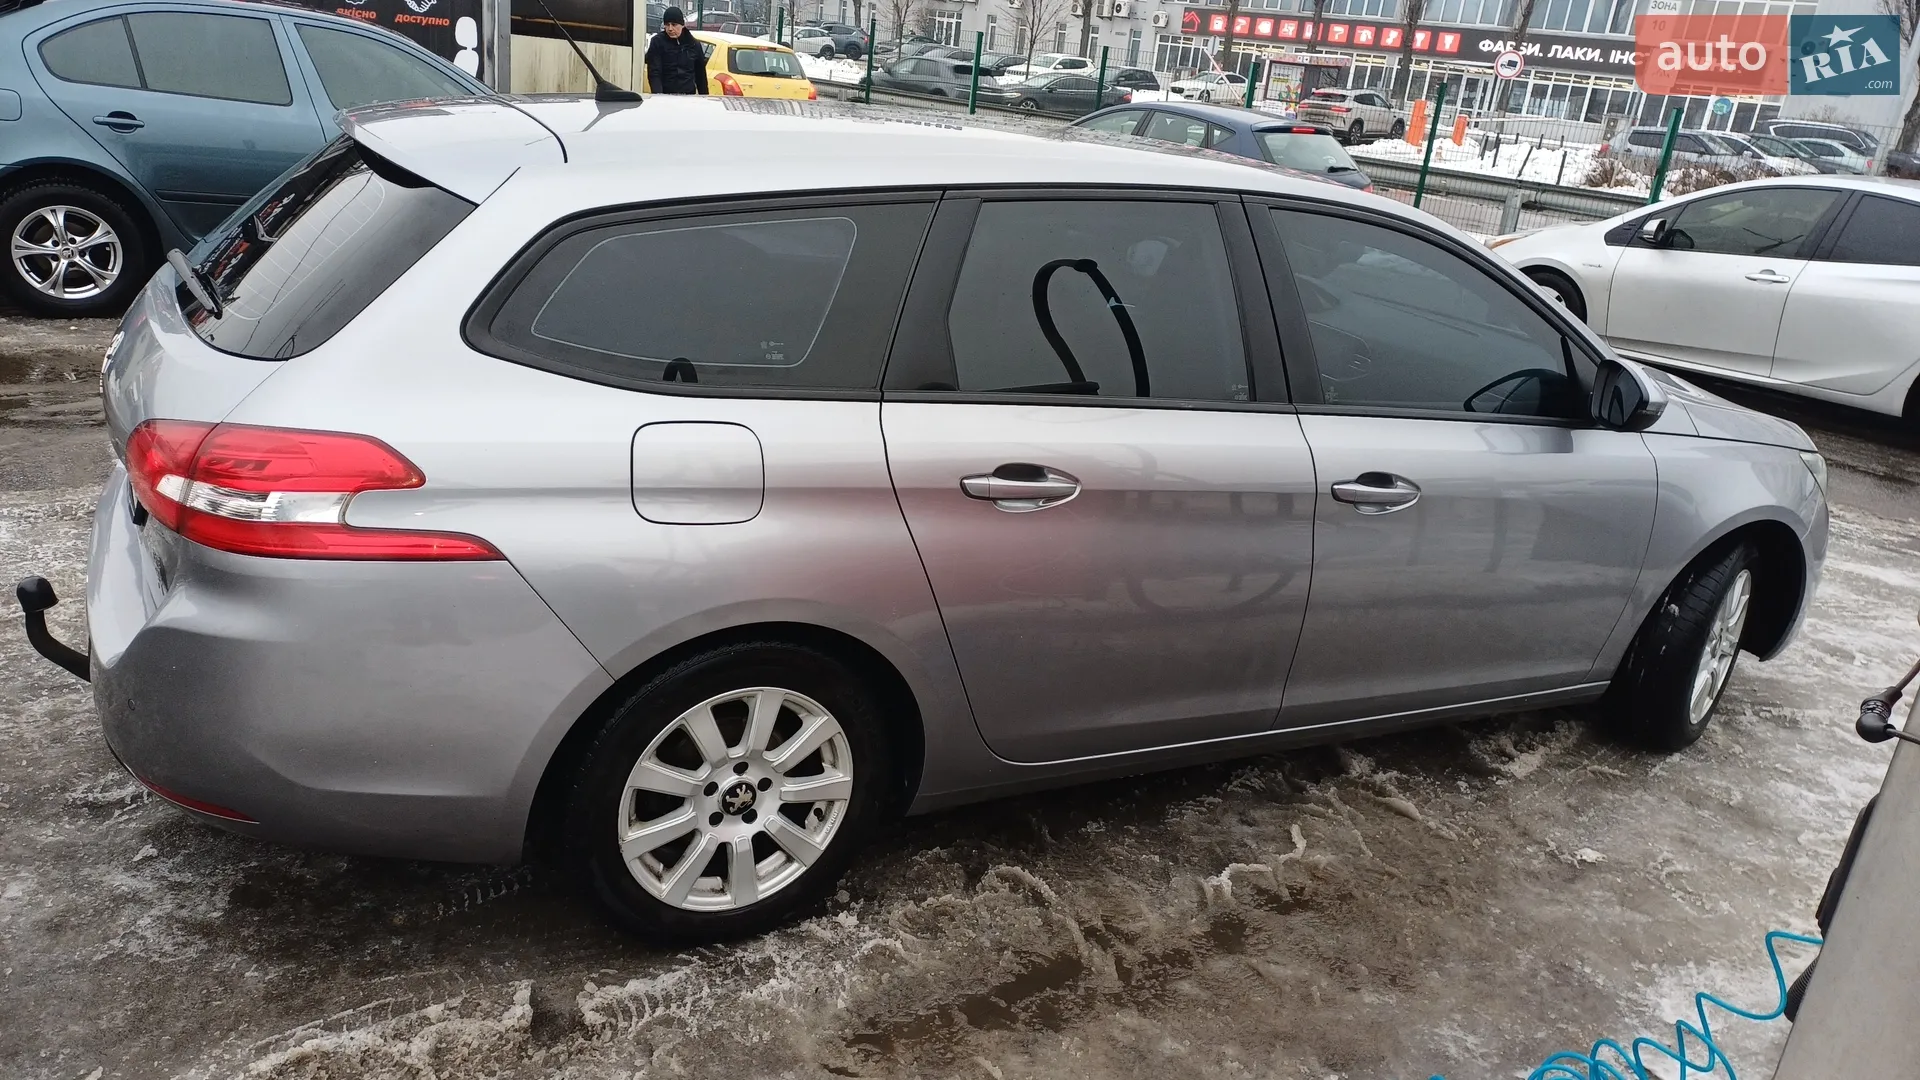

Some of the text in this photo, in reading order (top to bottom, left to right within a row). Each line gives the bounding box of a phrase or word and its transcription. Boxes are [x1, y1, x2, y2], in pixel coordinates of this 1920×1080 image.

[1651, 0, 1677, 11] ЗОНА
[395, 13, 450, 26] доступно
[1652, 19, 1666, 31] 10
[1547, 44, 1604, 62] ЛАКИ.
